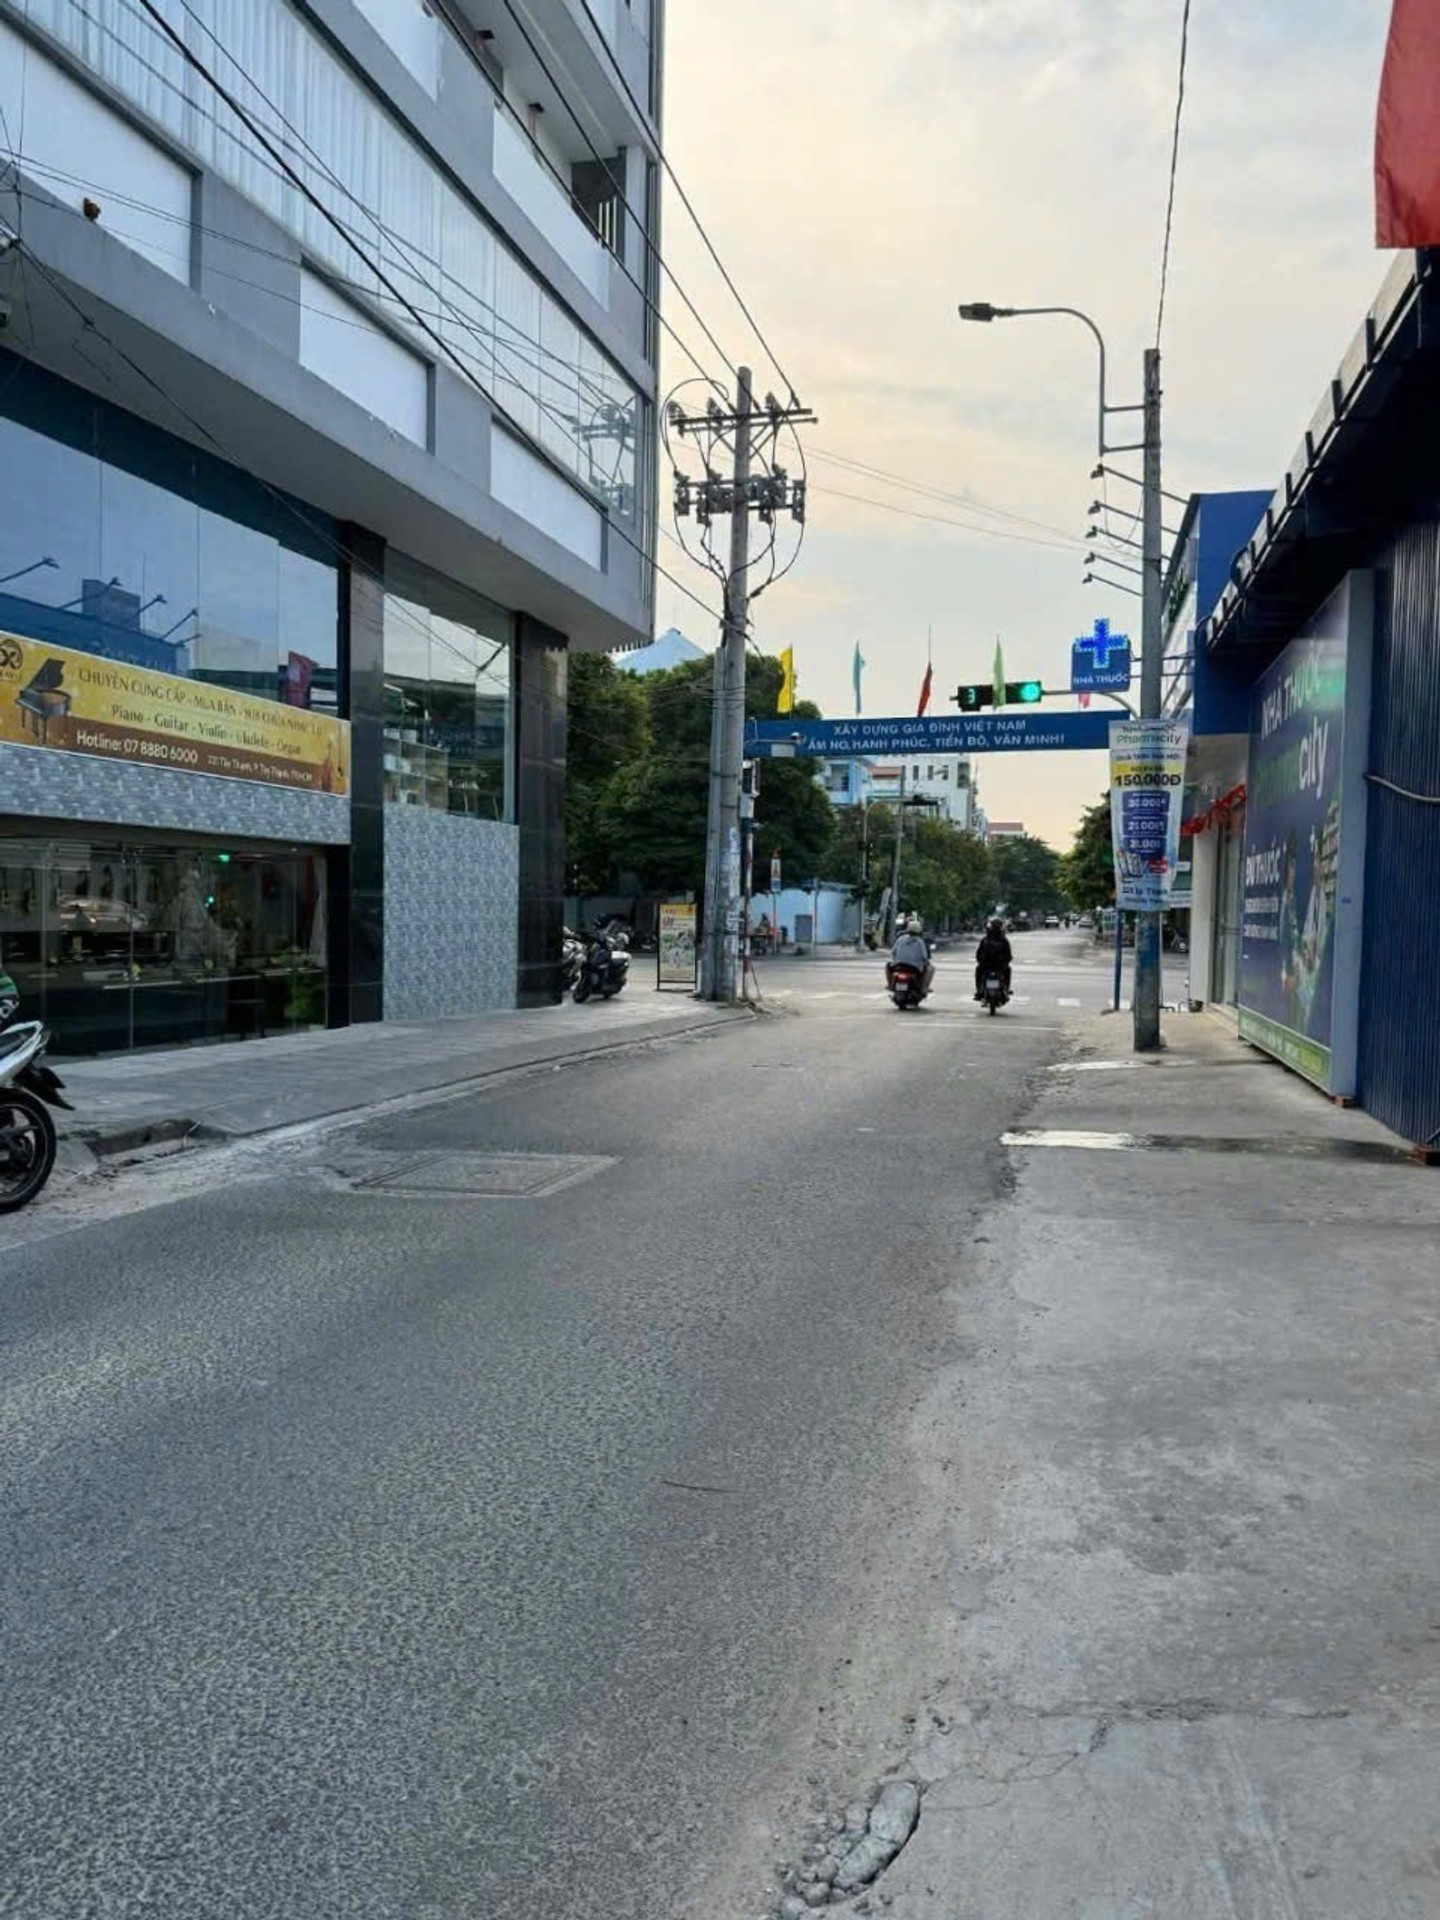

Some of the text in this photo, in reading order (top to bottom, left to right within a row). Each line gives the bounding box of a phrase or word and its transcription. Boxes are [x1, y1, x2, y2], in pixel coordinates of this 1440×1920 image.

[1073, 672, 1128, 685] NHÀ THUỐC
[131, 682, 165, 700] CUNG
[111, 704, 144, 722] Piano
[154, 714, 188, 732] Guitar
[198, 721, 226, 740] Violin
[834, 719, 1026, 737] XÂY DỰNG GIA ĐÌNH VIỆT NAM
[76, 729, 122, 752] Hotline:
[124, 738, 139, 753] 07
[169, 748, 199, 766] 6000
[934, 734, 963, 747] TIẾN
[993, 733, 1021, 746] VĂN
[1024, 733, 1066, 746] MINH!
